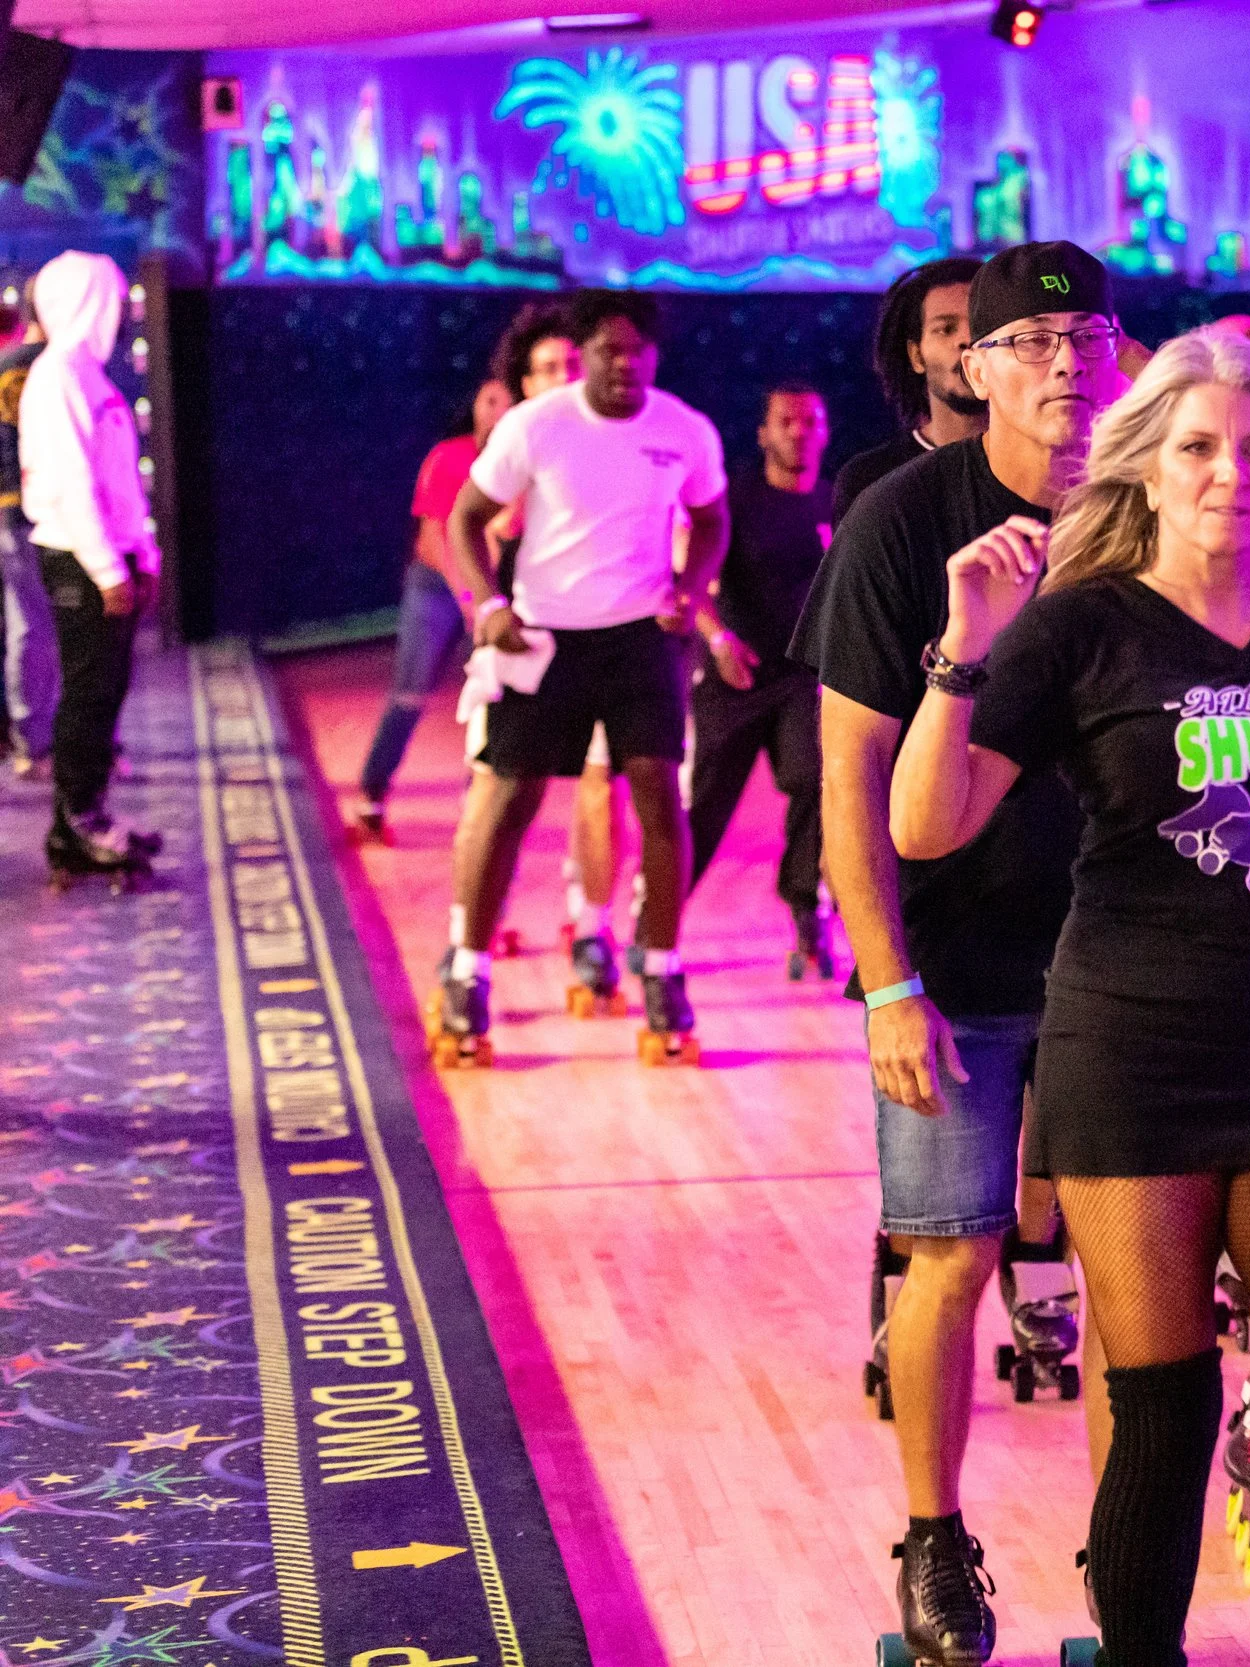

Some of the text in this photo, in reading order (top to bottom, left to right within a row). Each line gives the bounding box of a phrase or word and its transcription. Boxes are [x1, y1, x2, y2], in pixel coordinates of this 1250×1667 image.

[684, 55, 881, 216] USA
[285, 1195, 431, 1485] CAUTION STEP DOWN
